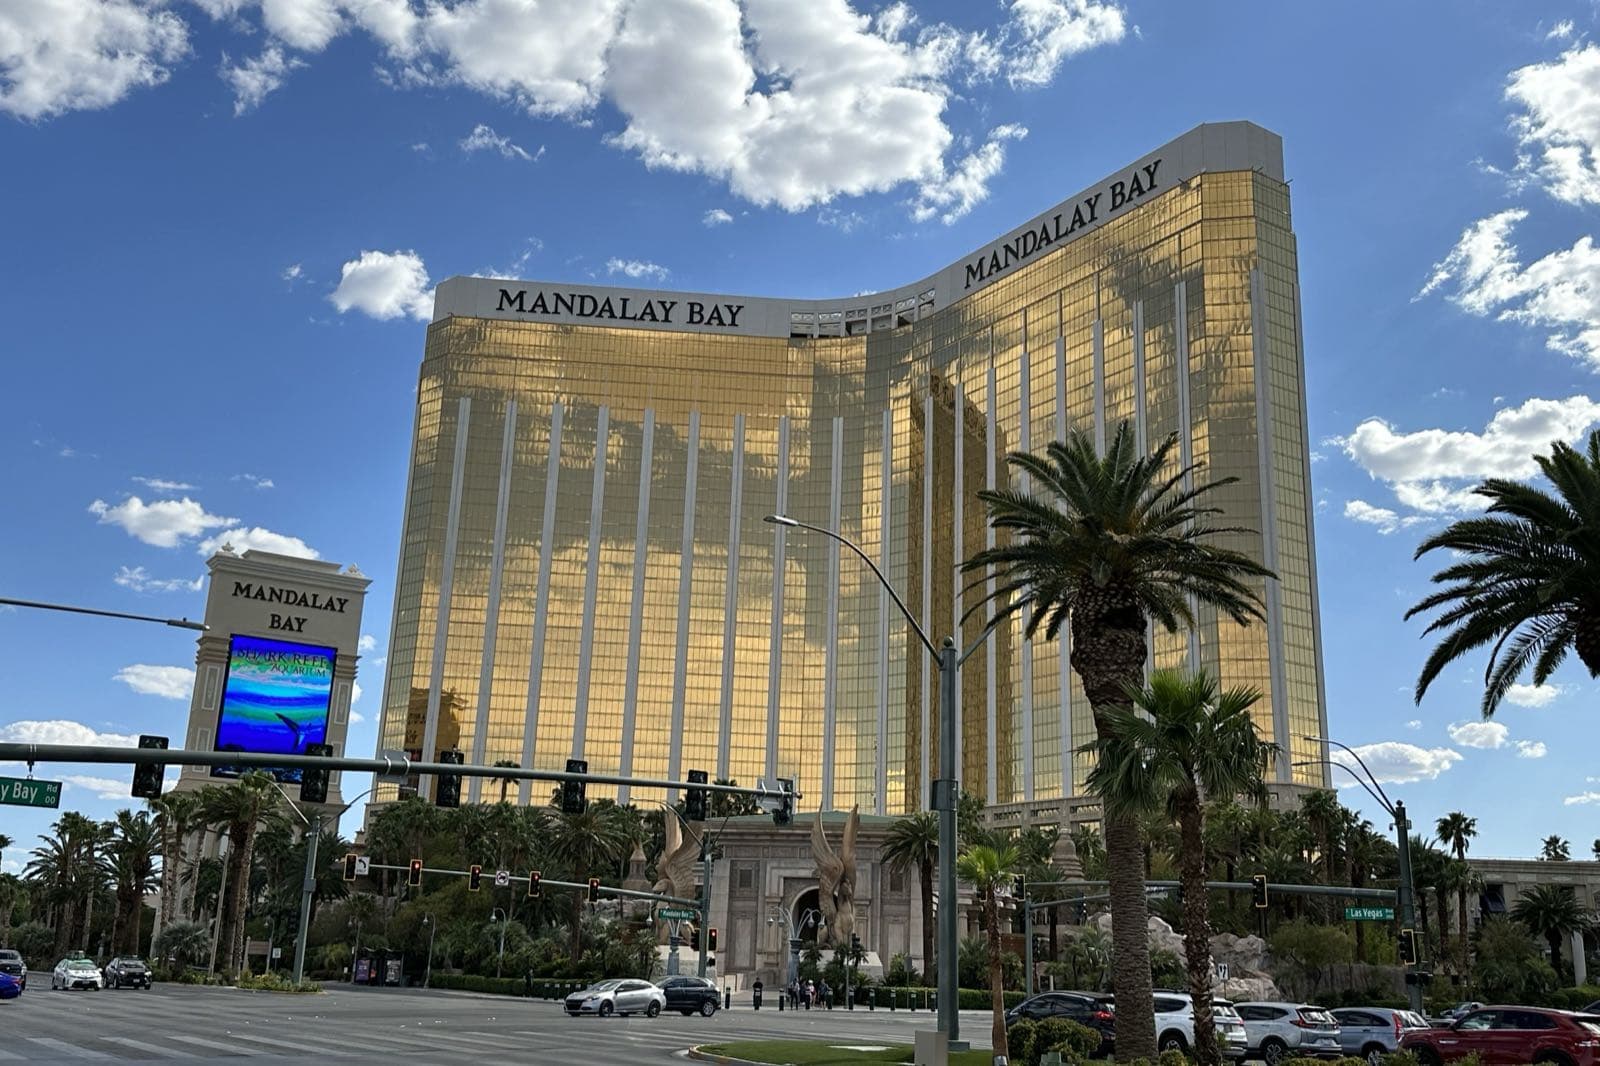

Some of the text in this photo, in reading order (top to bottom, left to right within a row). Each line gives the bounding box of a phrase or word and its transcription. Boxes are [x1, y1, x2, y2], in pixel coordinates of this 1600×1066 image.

[964, 159, 1162, 290] MANDALAY BAY
[496, 289, 745, 327] MANDALAY BAY
[231, 581, 349, 614] MANDALAY
[269, 614, 308, 633] BAY
[237, 648, 327, 668] SHARK REEF
[271, 663, 327, 678] AQUARIUM
[12, 781, 38, 804] Bay
[46, 784, 58, 793] Rd
[1350, 908, 1362, 918] Las
[1362, 907, 1383, 920] Vegas
